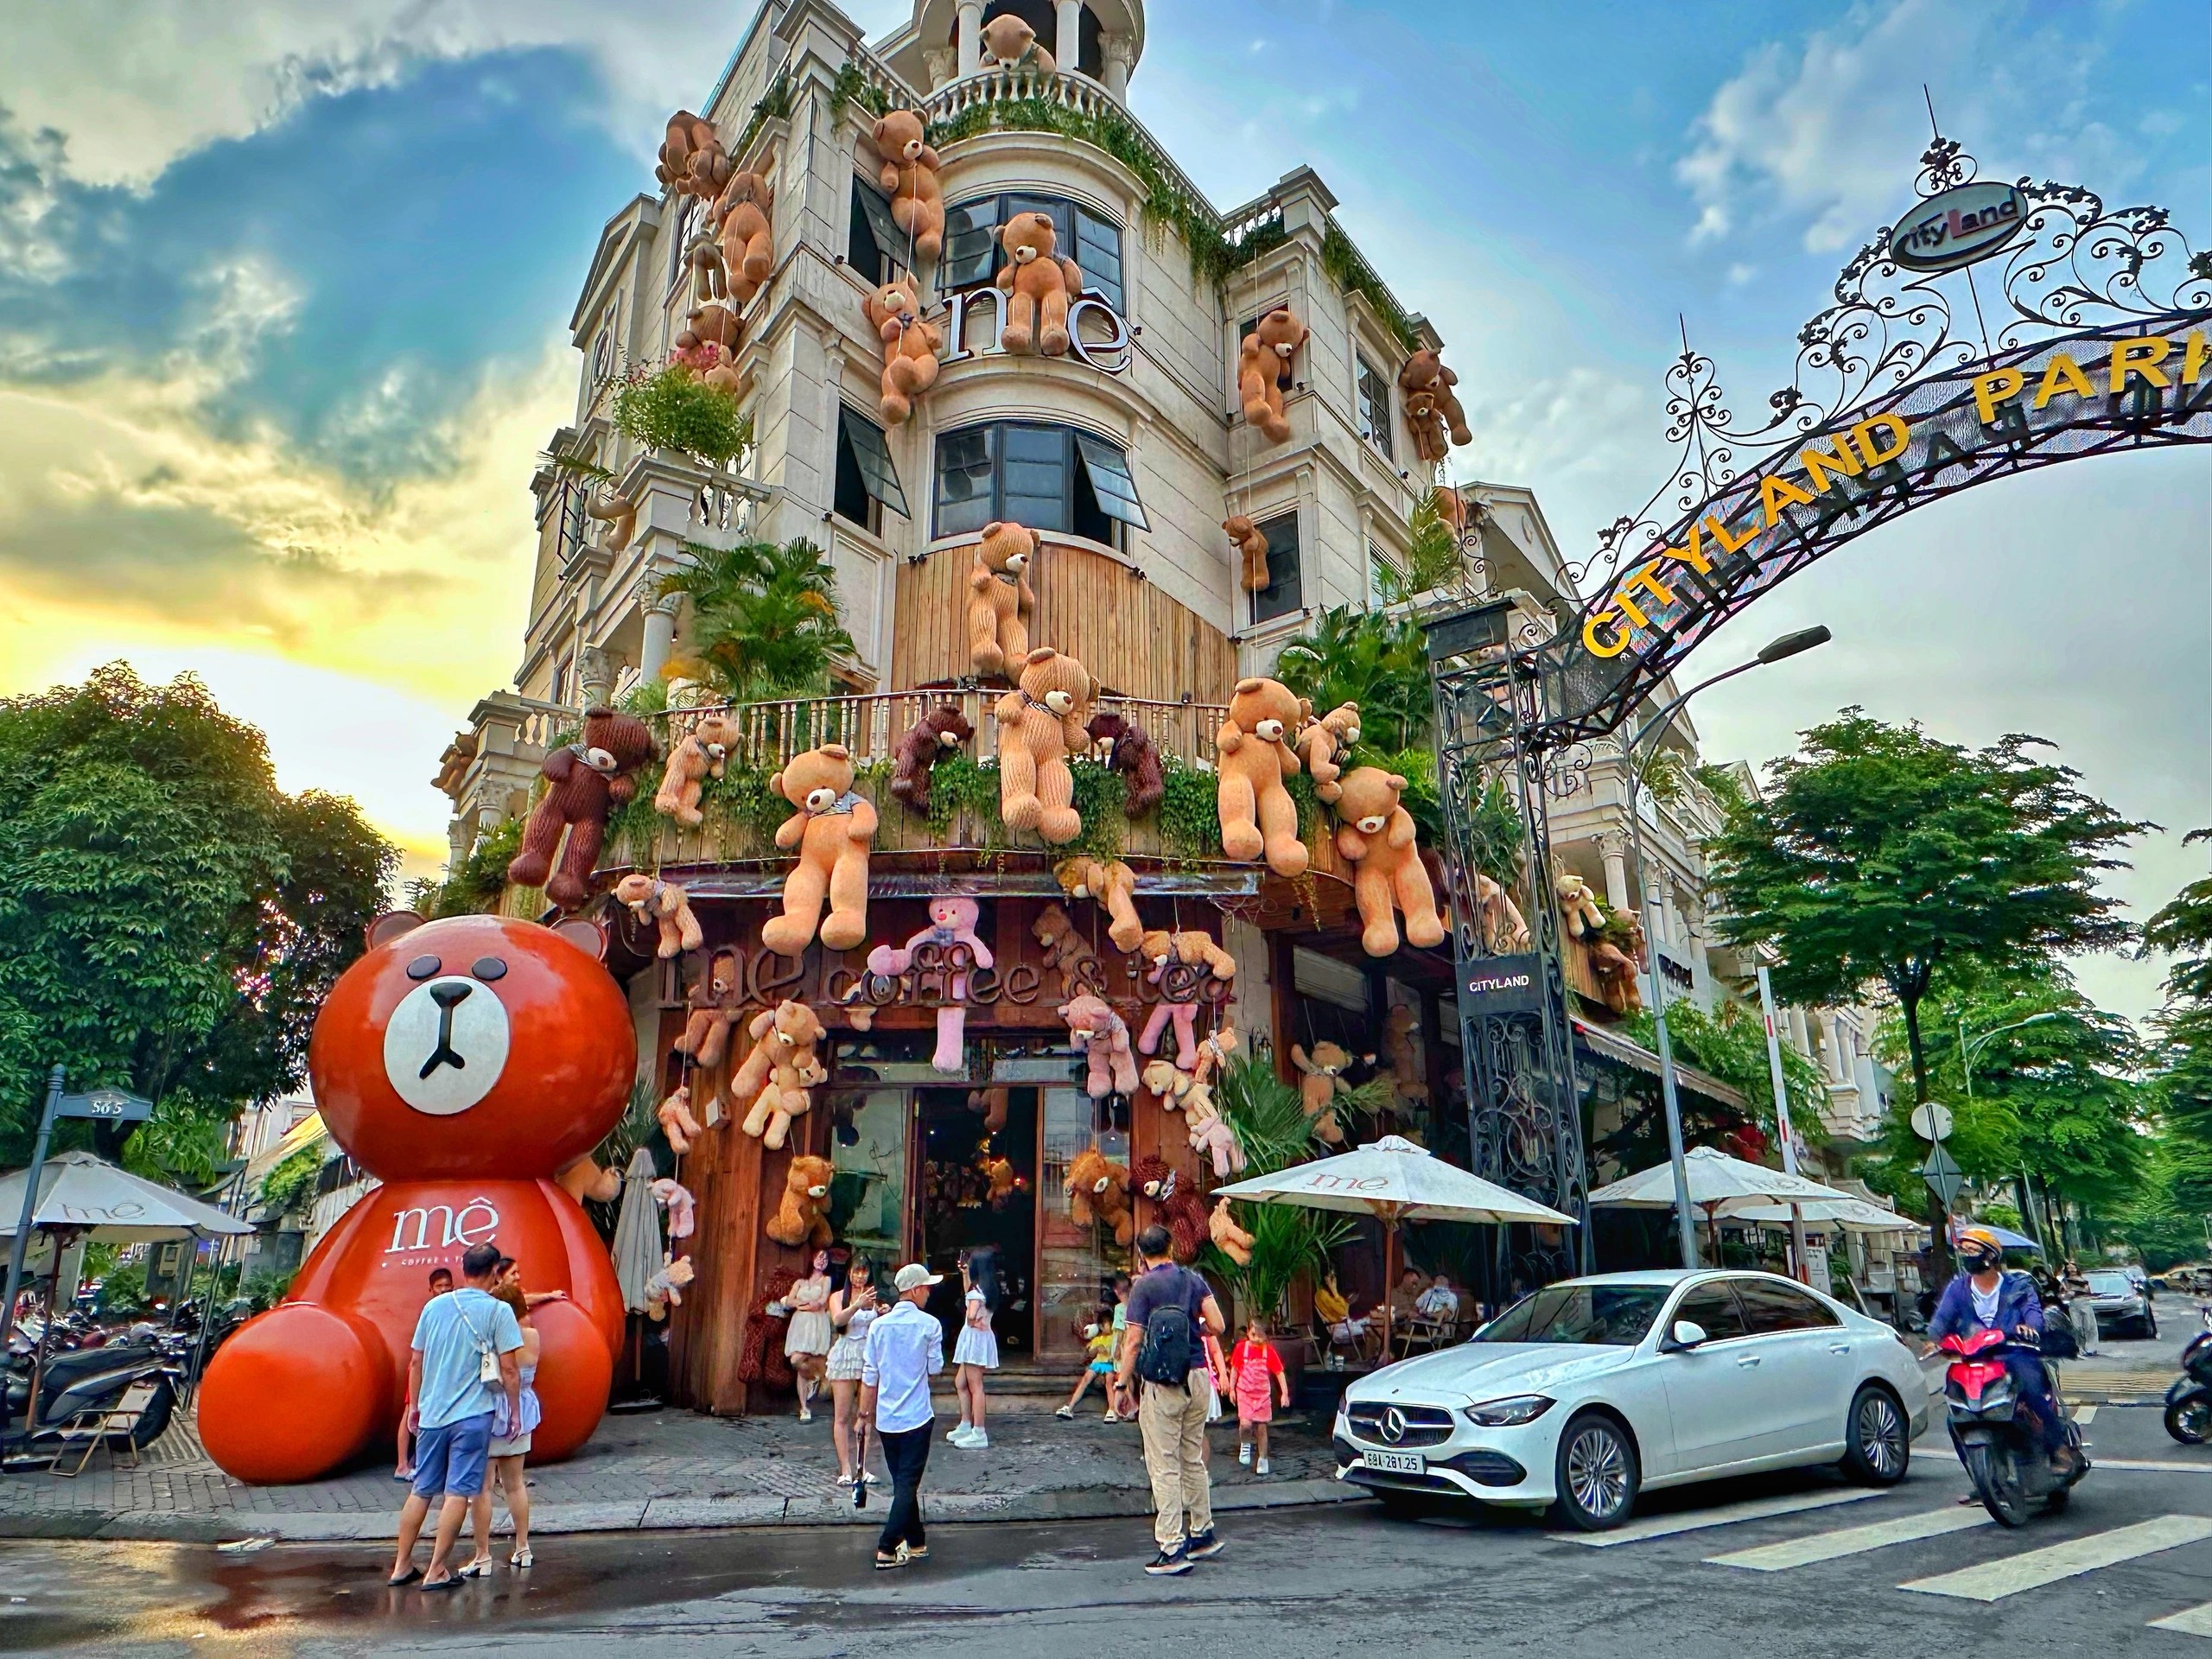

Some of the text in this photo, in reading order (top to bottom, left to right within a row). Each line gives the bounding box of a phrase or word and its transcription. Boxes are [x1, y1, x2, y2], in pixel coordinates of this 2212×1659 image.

[1582, 412, 1910, 659] CITYLAND
[1469, 975, 1529, 992] CITYLAND
[112, 1102, 124, 1115] 5
[385, 1196, 499, 1253] mê
